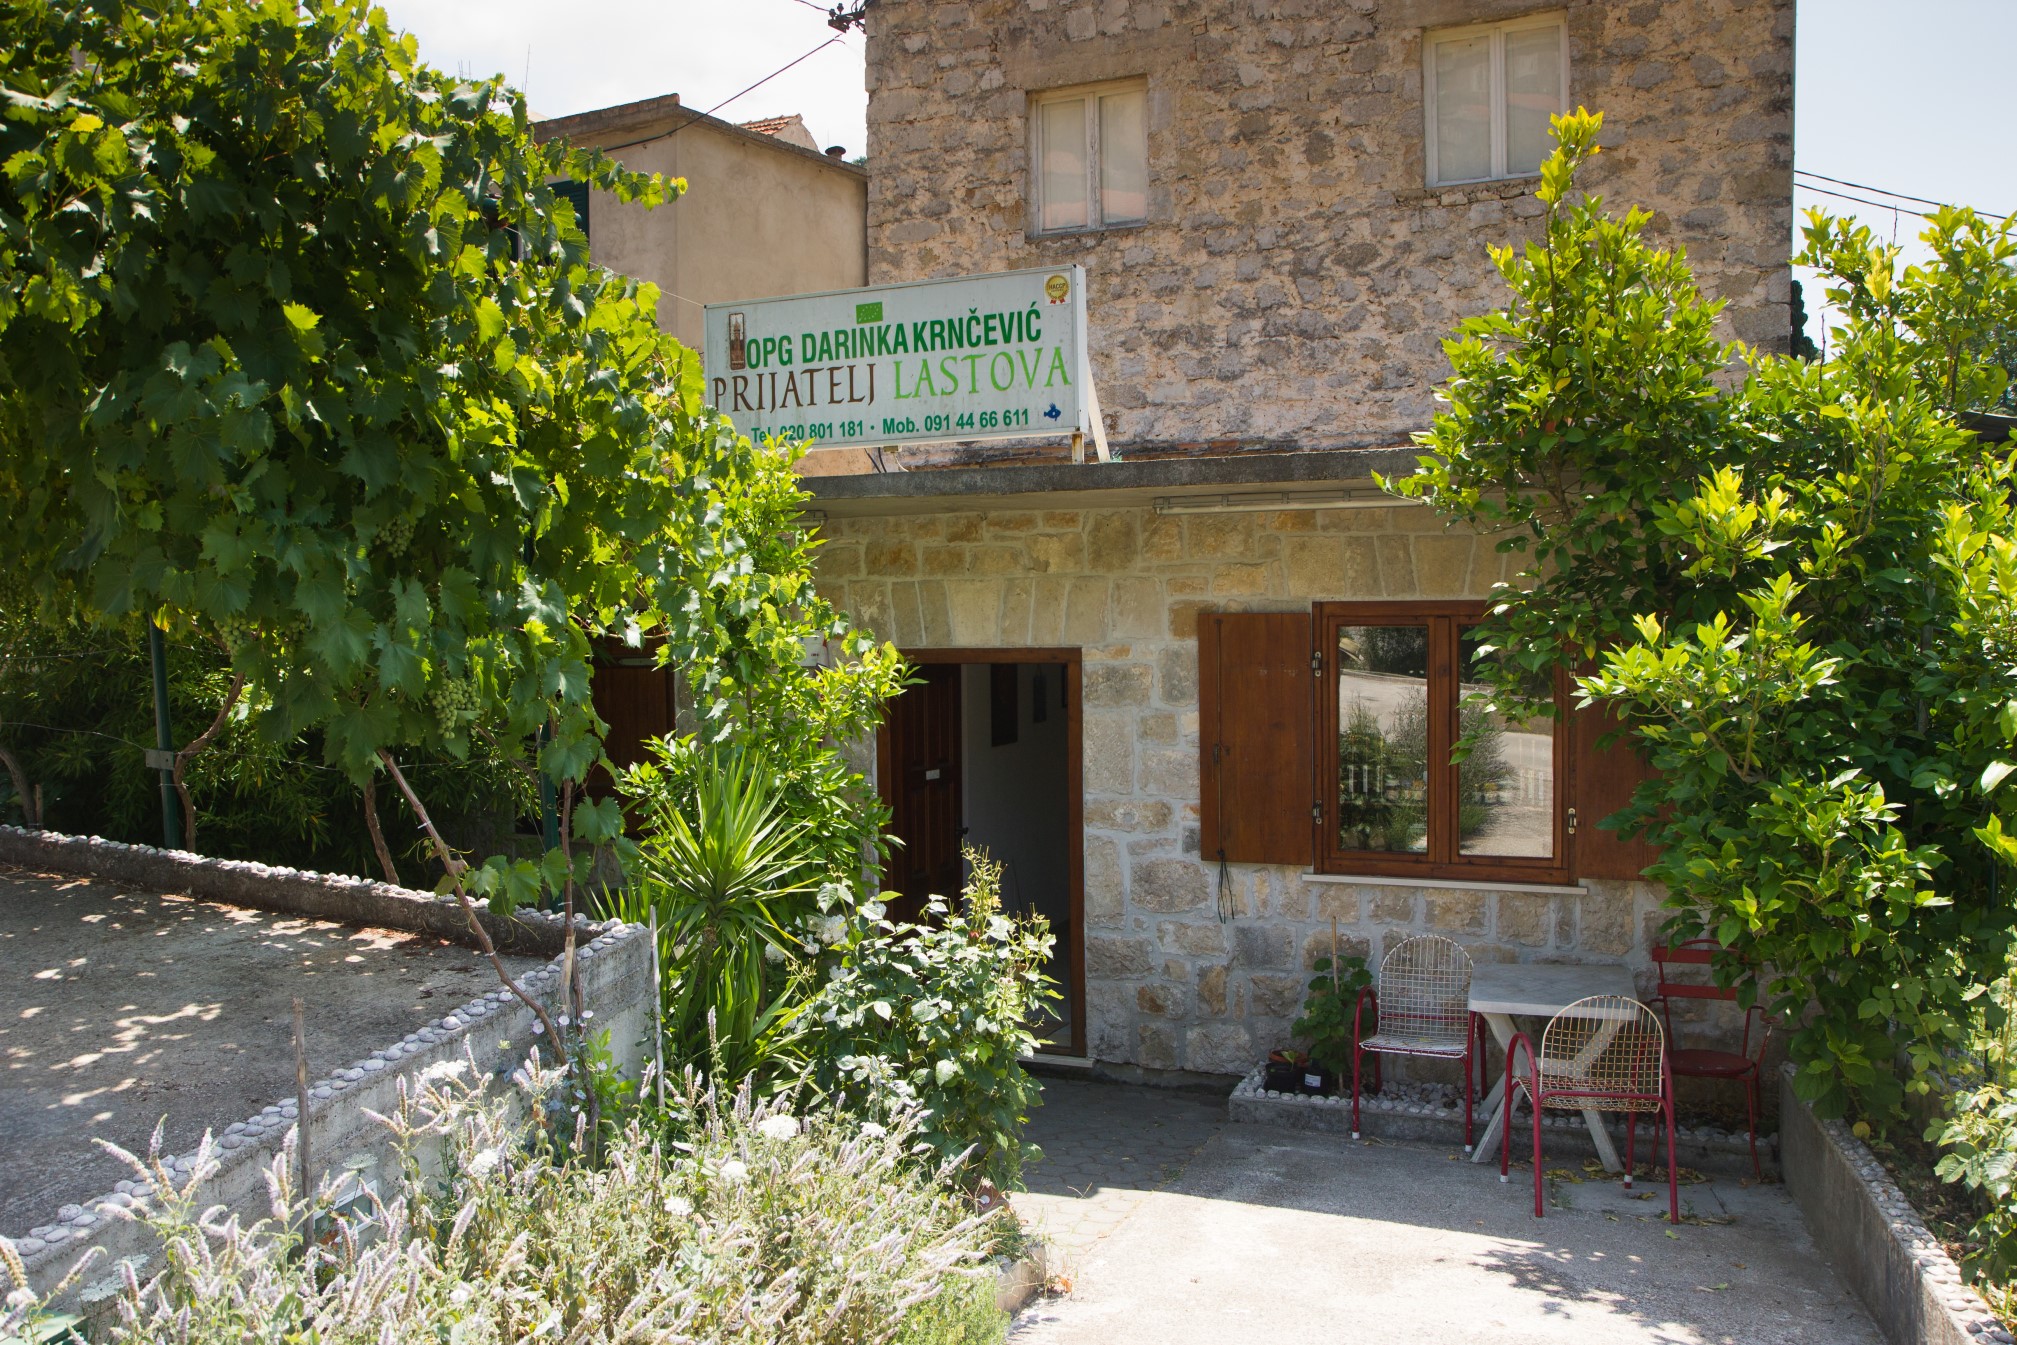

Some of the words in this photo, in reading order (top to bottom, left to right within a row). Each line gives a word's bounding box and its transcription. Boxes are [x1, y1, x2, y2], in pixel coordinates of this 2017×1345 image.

[746, 335, 793, 369] OPG
[802, 323, 909, 364] DARINKA
[913, 301, 1041, 353] KRNČEVIĆ
[712, 363, 876, 413] PRIJATELJ
[893, 346, 1072, 400] LASTOVA
[809, 422, 833, 439] 801
[839, 420, 863, 437] 181
[883, 418, 920, 434] Mob.
[924, 414, 950, 432] 091
[956, 411, 975, 429] 44
[979, 411, 998, 428] 66
[1003, 408, 1029, 427] 611
